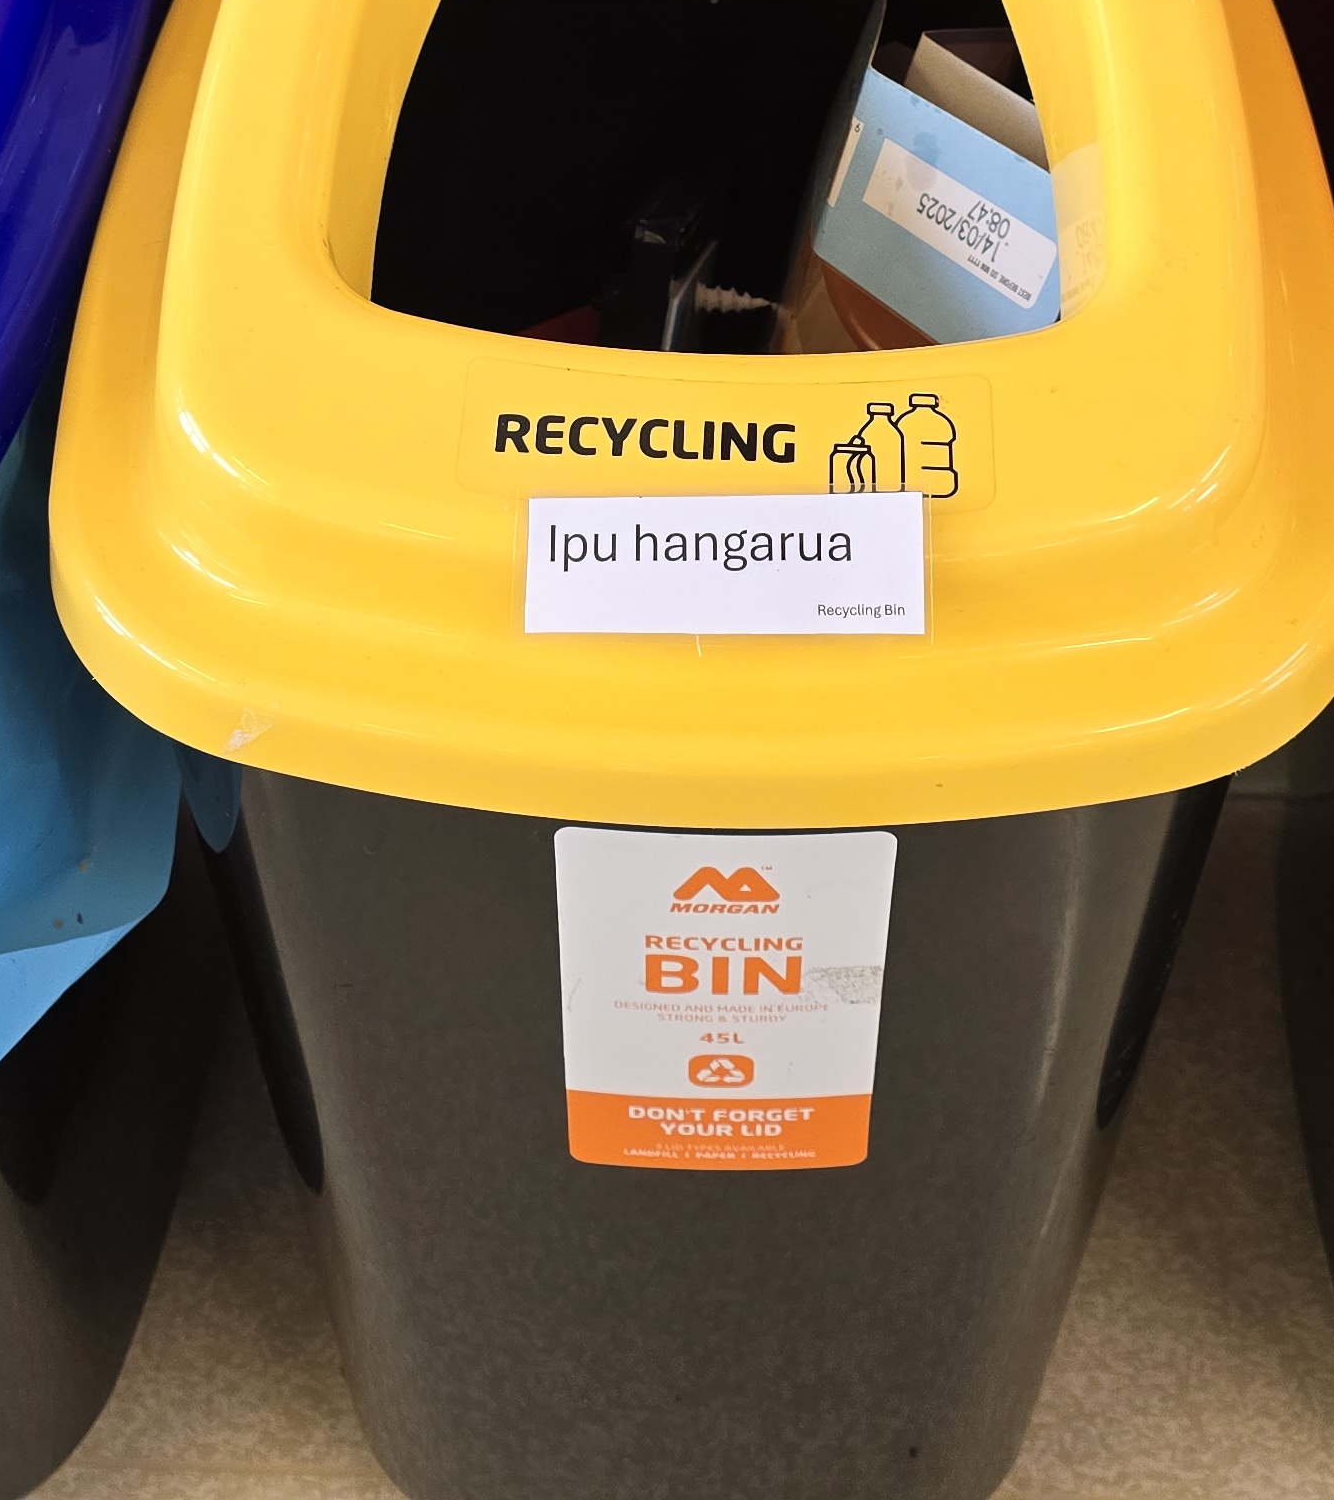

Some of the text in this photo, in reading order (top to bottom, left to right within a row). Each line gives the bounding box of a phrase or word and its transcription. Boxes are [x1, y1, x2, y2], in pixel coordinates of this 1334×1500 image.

[916, 193, 999, 262] 14/03/2025
[967, 200, 1010, 239] 08:47
[495, 414, 795, 463] RECYCLING
[550, 524, 851, 572] Ipu hangarua
[818, 604, 905, 618] Recycling Bin
[670, 903, 779, 914] MORGAN
[645, 935, 802, 951] RECYCLING
[645, 954, 802, 995] BIN
[700, 1033, 743, 1044] 45L
[629, 1106, 814, 1122] DON'T FORGET
[660, 1122, 781, 1136] YOUR LID
